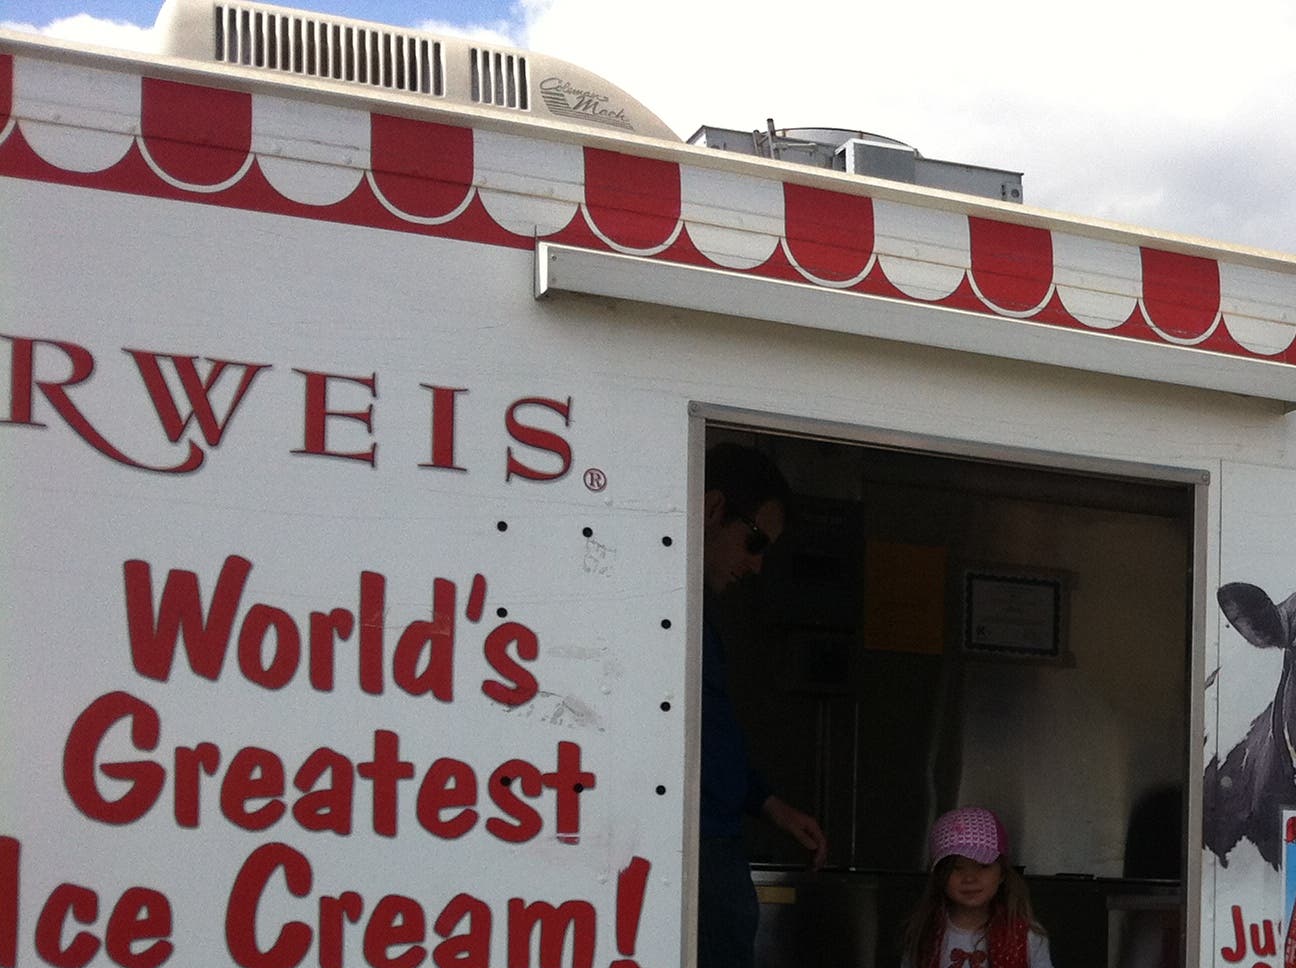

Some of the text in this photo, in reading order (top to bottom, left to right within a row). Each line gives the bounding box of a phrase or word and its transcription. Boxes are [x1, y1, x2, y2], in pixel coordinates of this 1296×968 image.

[122, 554, 541, 706] World's
[62, 690, 597, 845] Greatest
[1221, 905, 1282, 962] Ju
